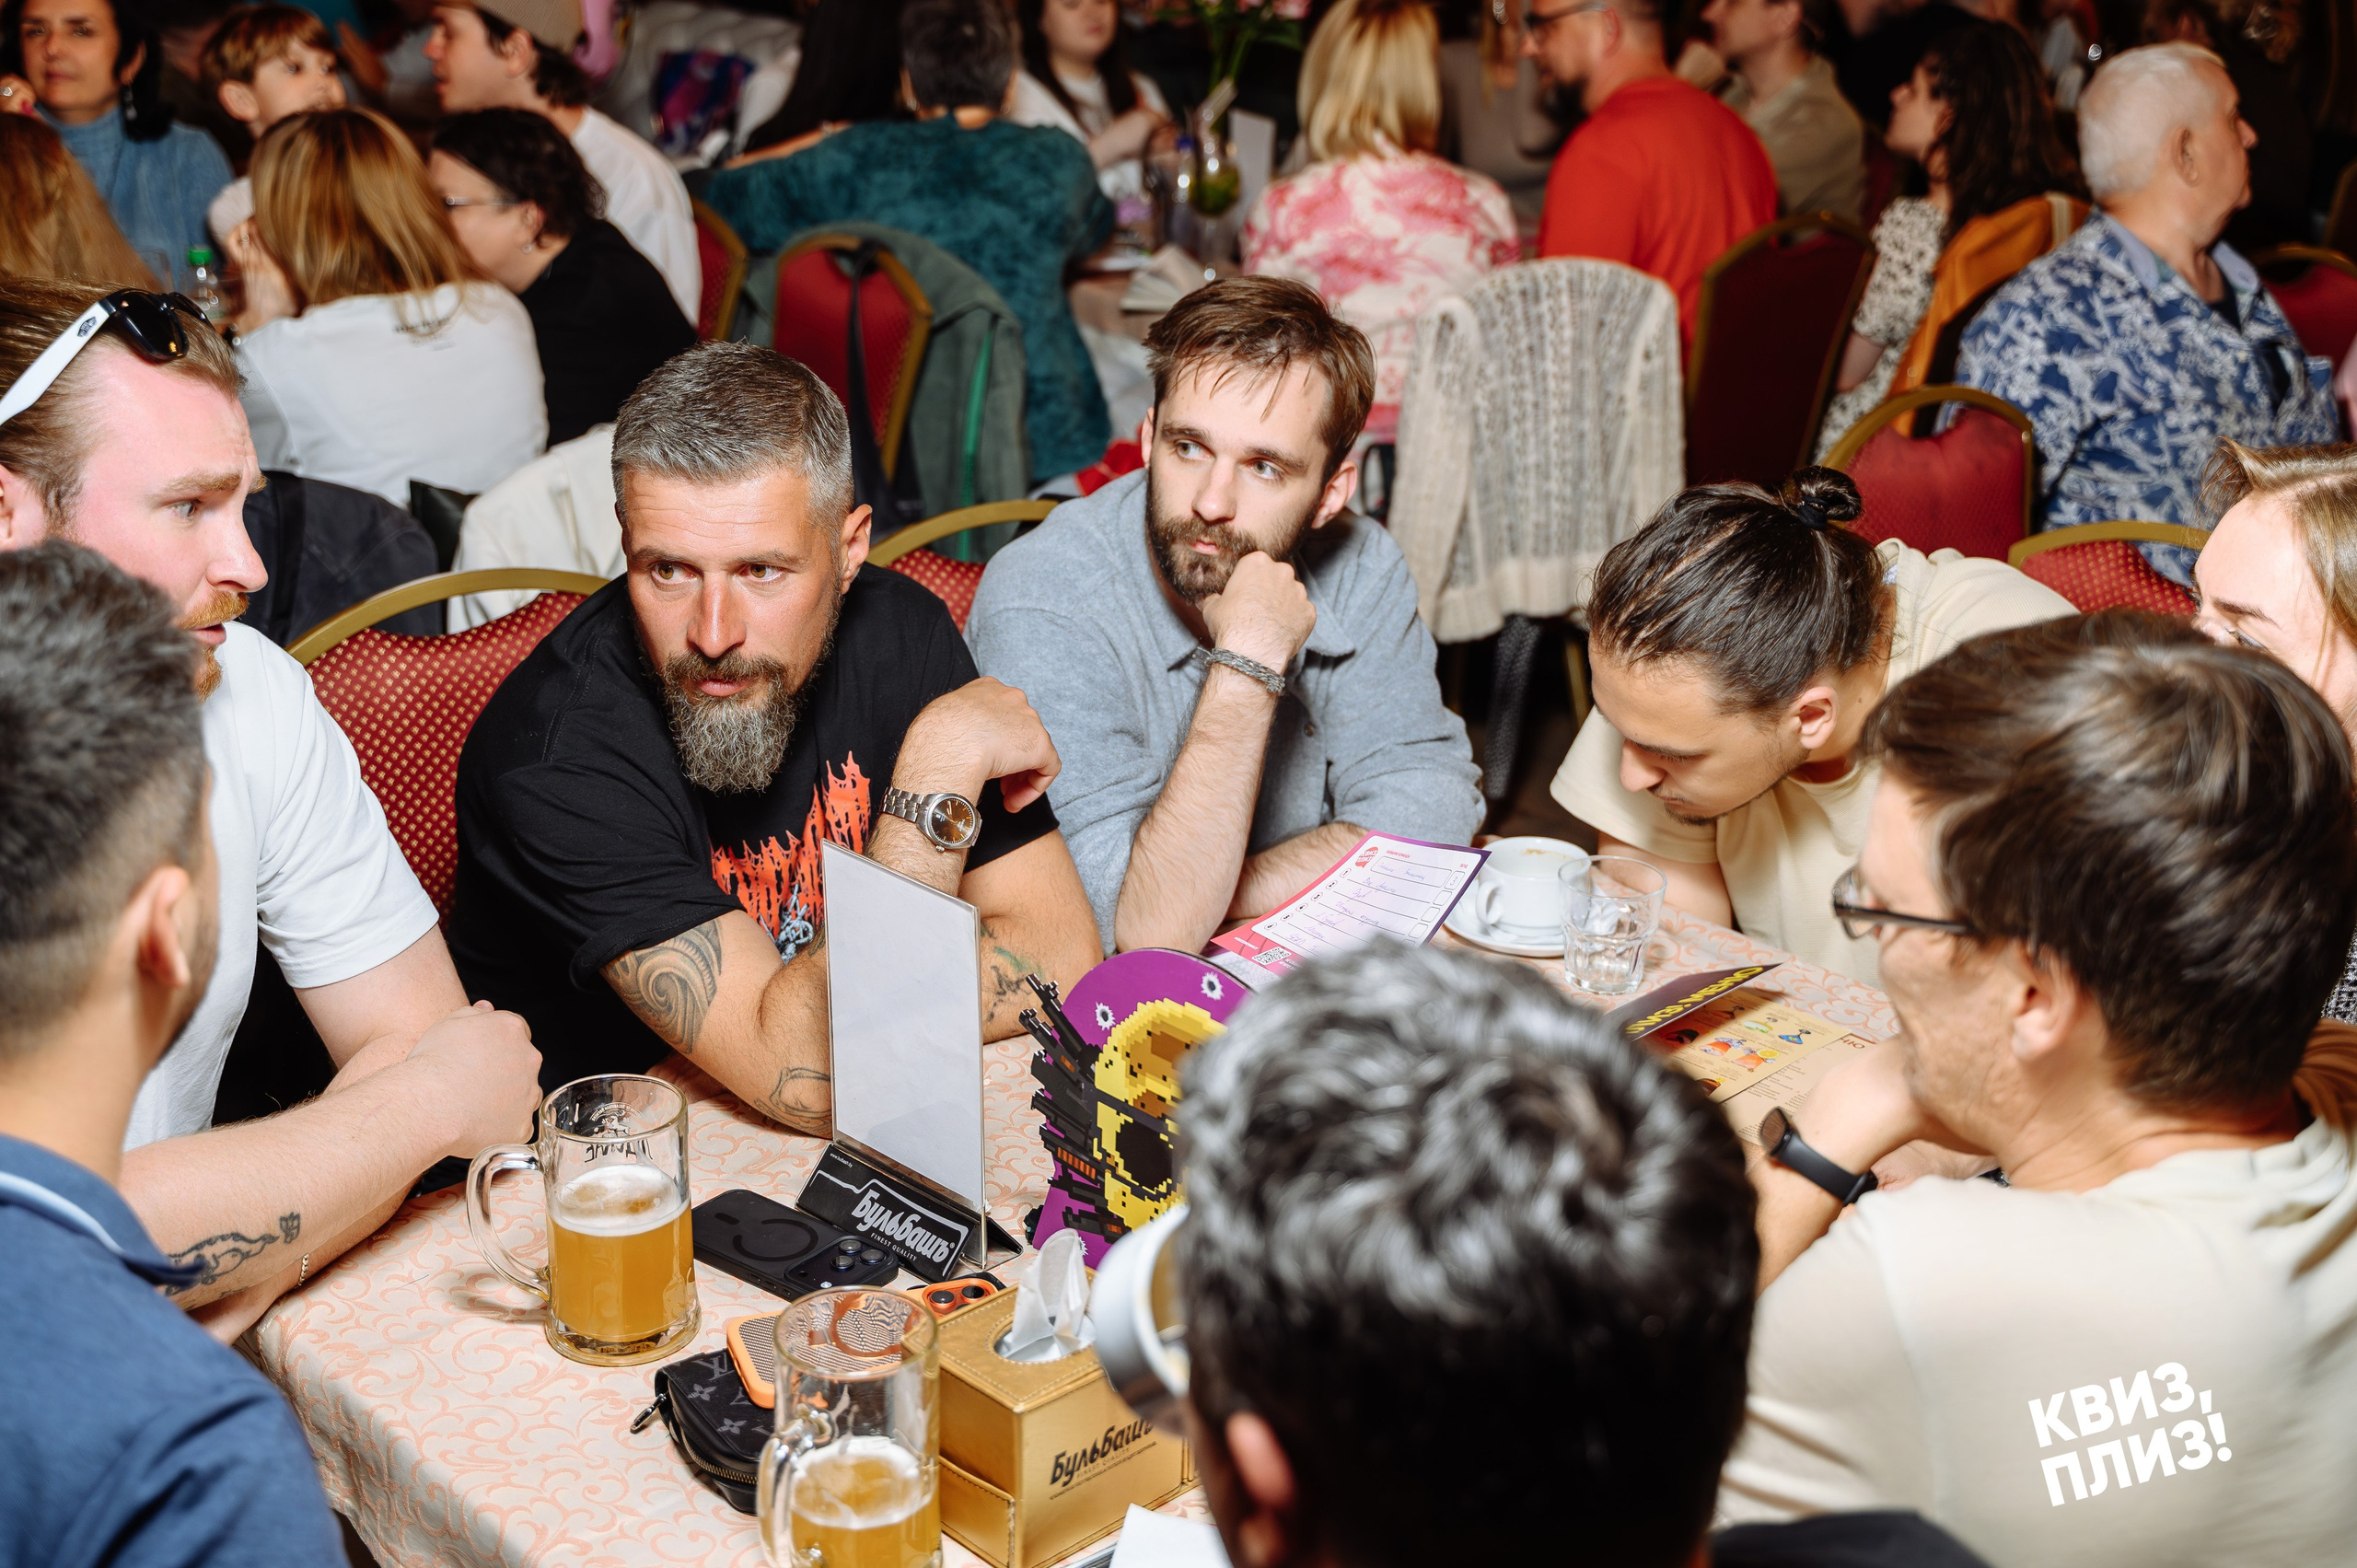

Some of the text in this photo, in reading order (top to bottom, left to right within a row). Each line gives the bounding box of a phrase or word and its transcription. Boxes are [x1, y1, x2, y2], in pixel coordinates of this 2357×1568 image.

[1624, 966, 1764, 1034] ЛИЗ! МЕНЮ
[852, 1189, 950, 1263] Бульбашъ
[870, 1232, 918, 1262] FINEST QUALITY
